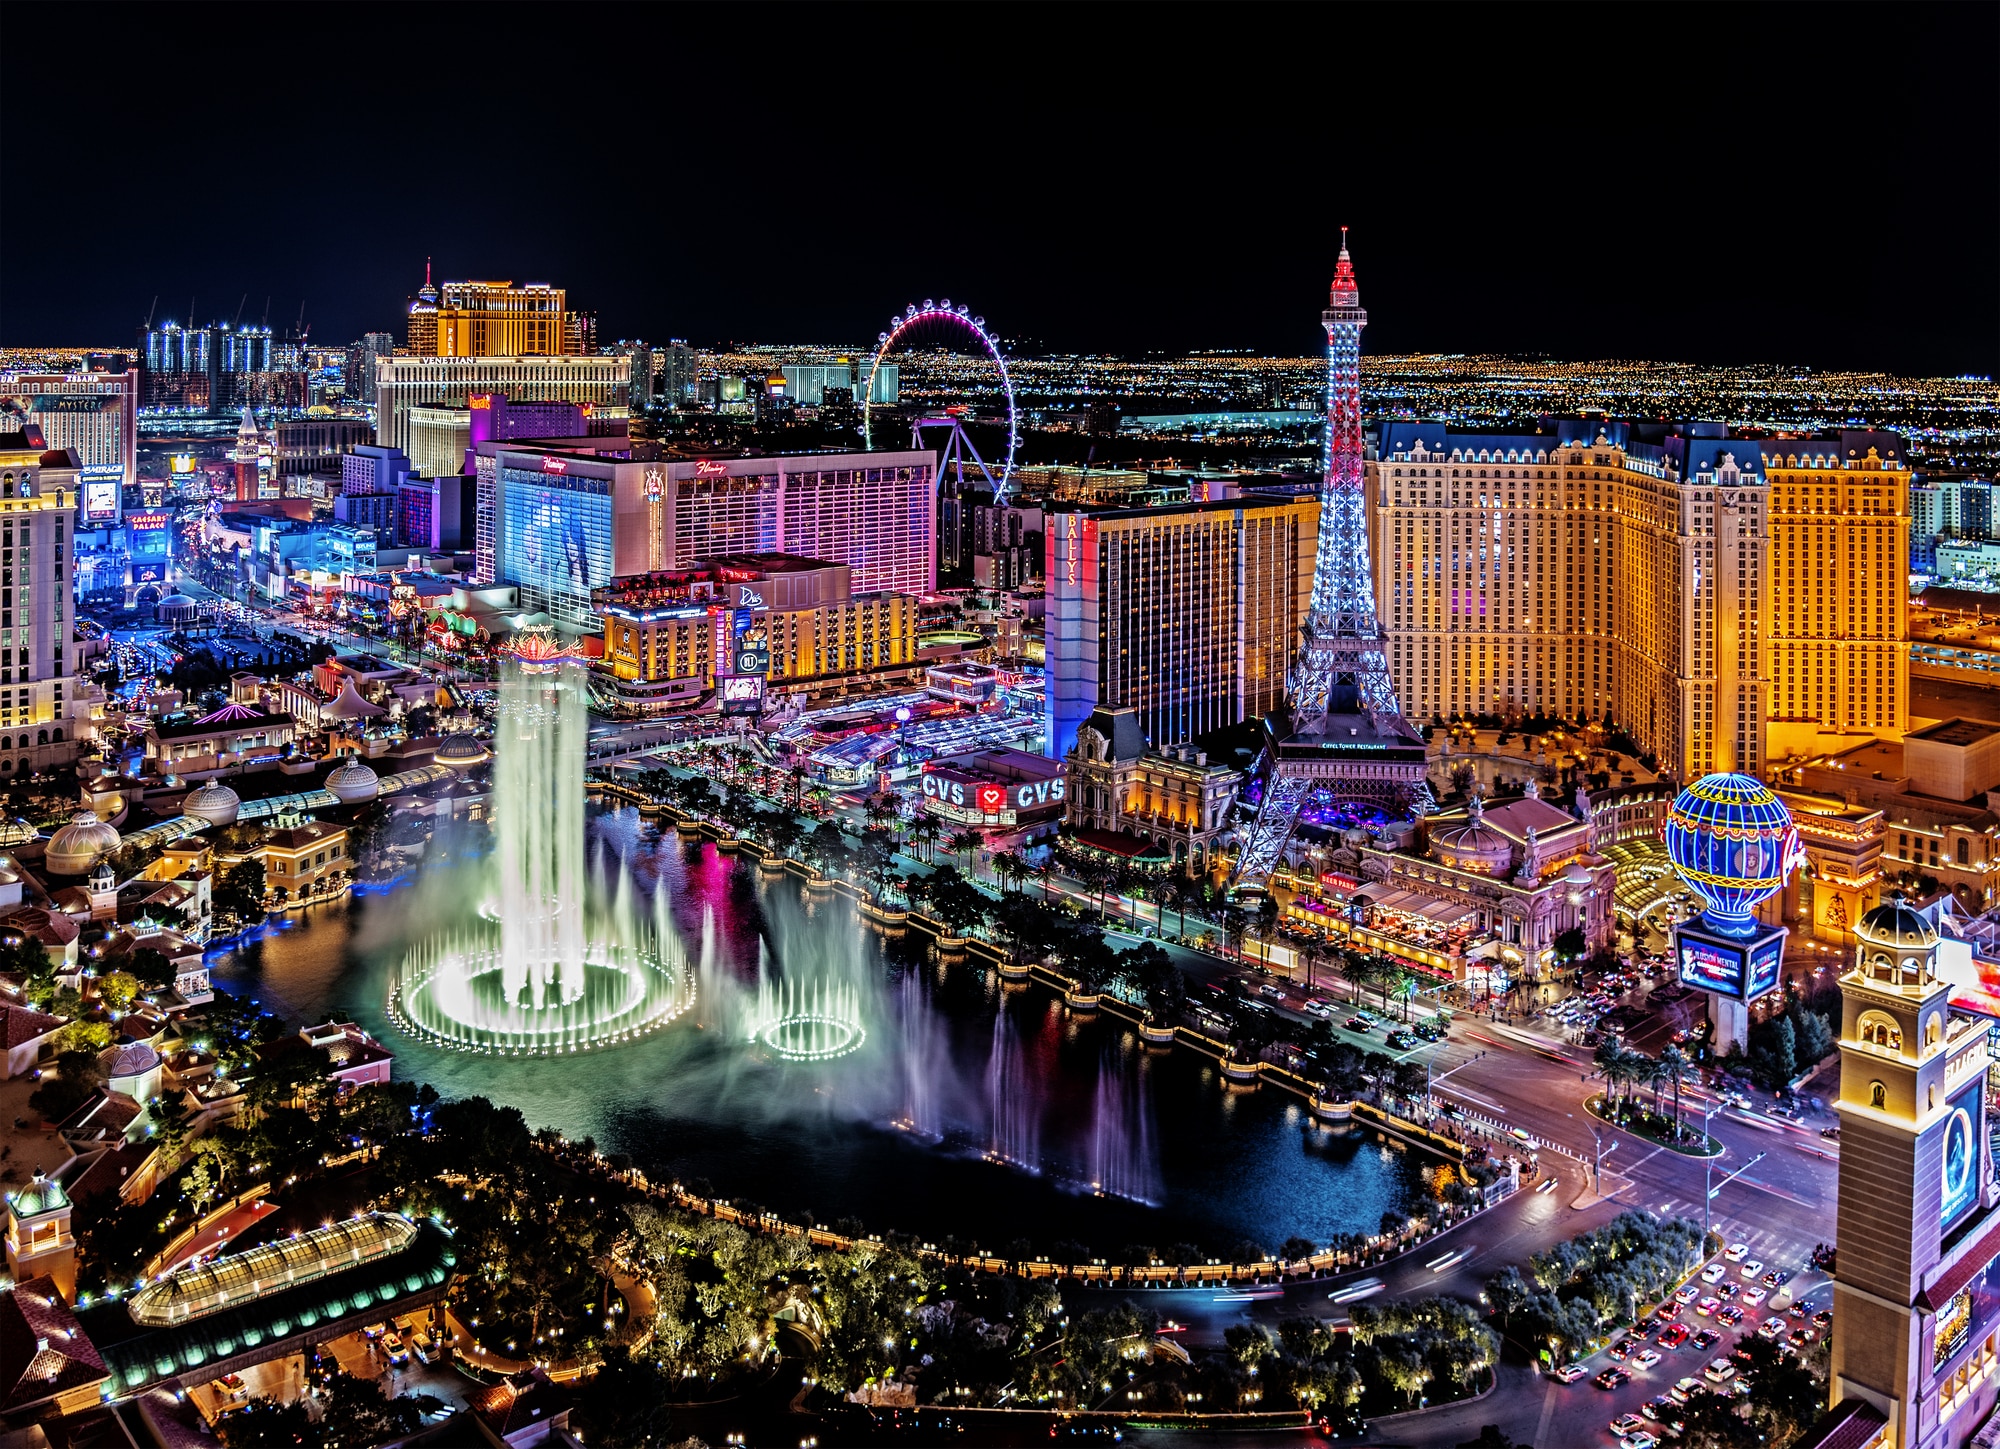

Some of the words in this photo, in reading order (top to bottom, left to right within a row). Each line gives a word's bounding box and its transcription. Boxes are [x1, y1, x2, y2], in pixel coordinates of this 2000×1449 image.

[922, 774, 965, 806] CVS
[1018, 778, 1065, 807] CVS
[1322, 875, 1338, 886] BEER
[1339, 879, 1355, 890] PARK
[1717, 957, 1739, 970] MENTAL
